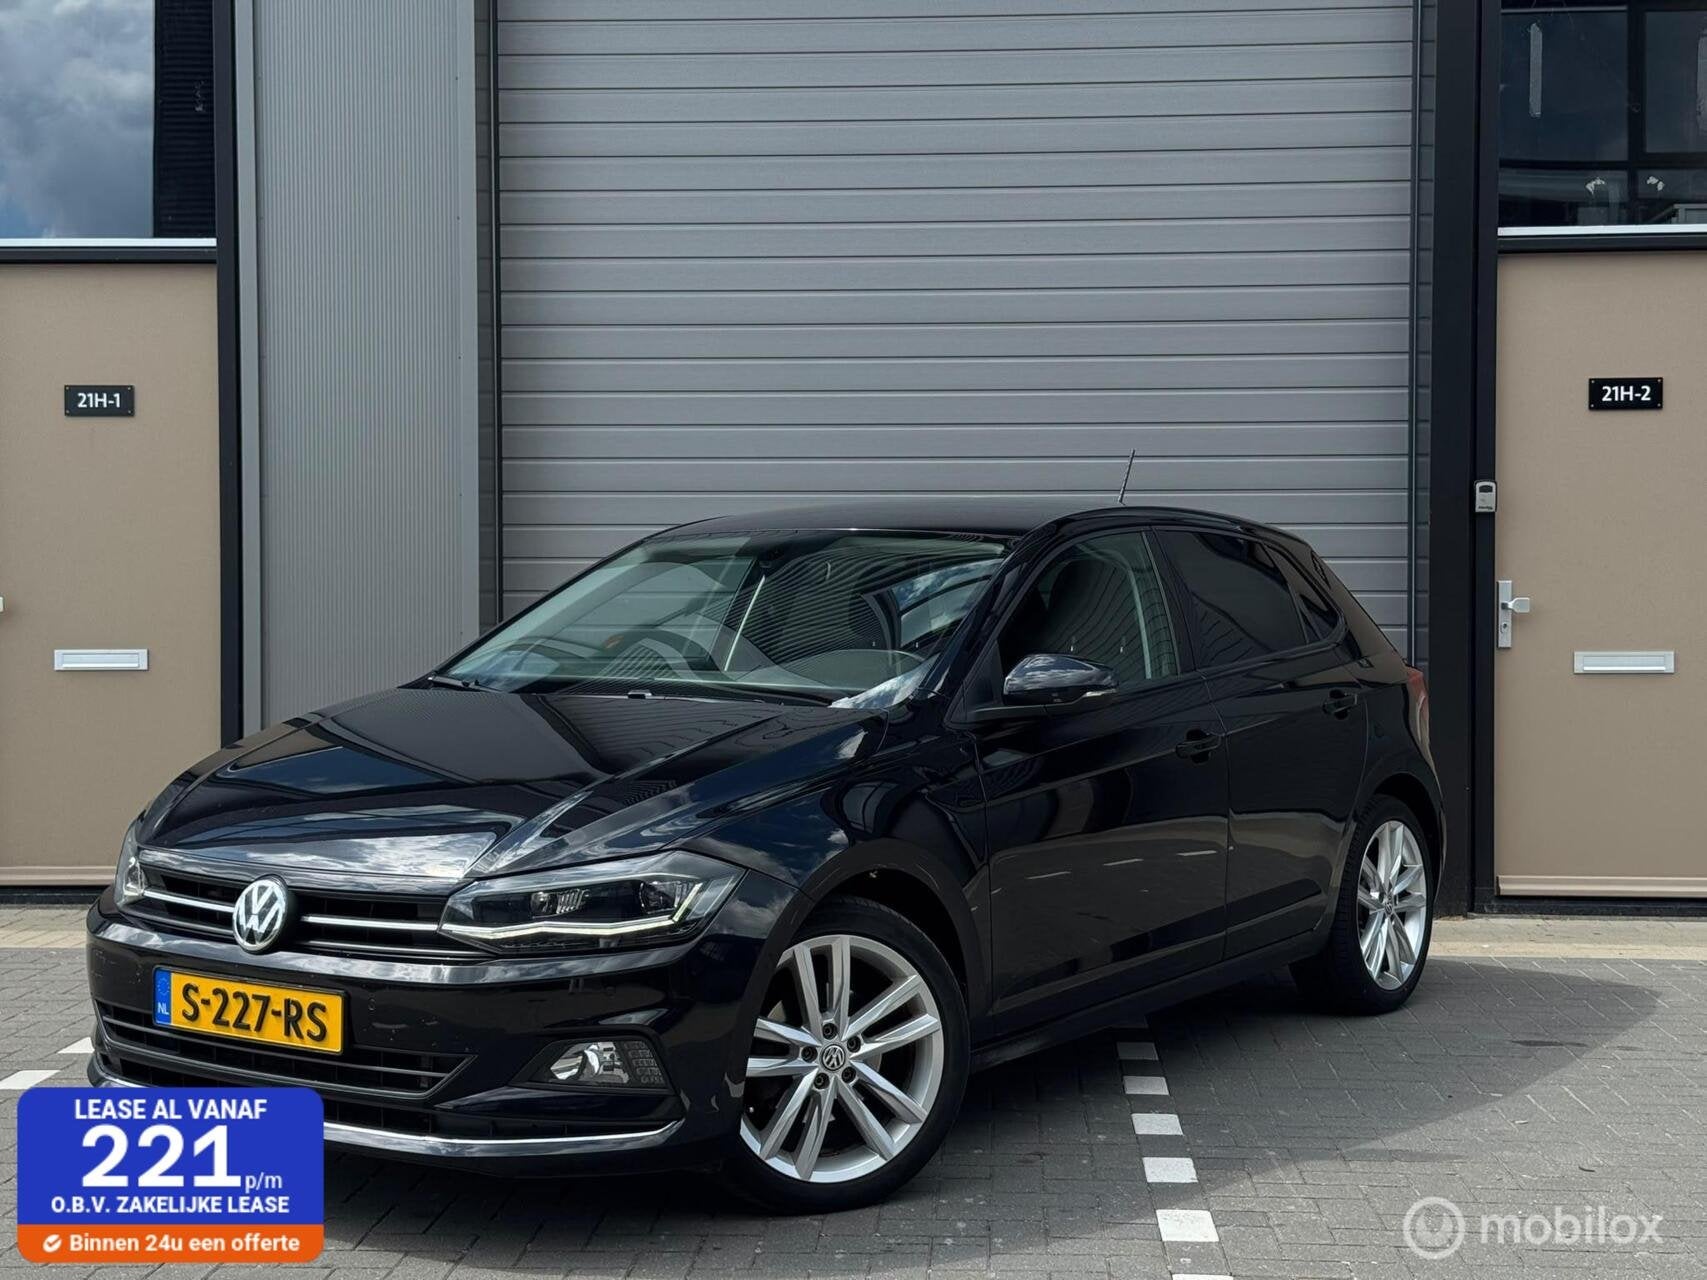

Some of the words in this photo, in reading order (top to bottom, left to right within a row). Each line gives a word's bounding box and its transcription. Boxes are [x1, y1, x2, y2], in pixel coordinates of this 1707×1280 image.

[77, 392, 121, 408] 21H-1
[1601, 385, 1652, 402] 21H-2
[156, 1001, 170, 1016] NL
[181, 982, 327, 1042] S-227-RS
